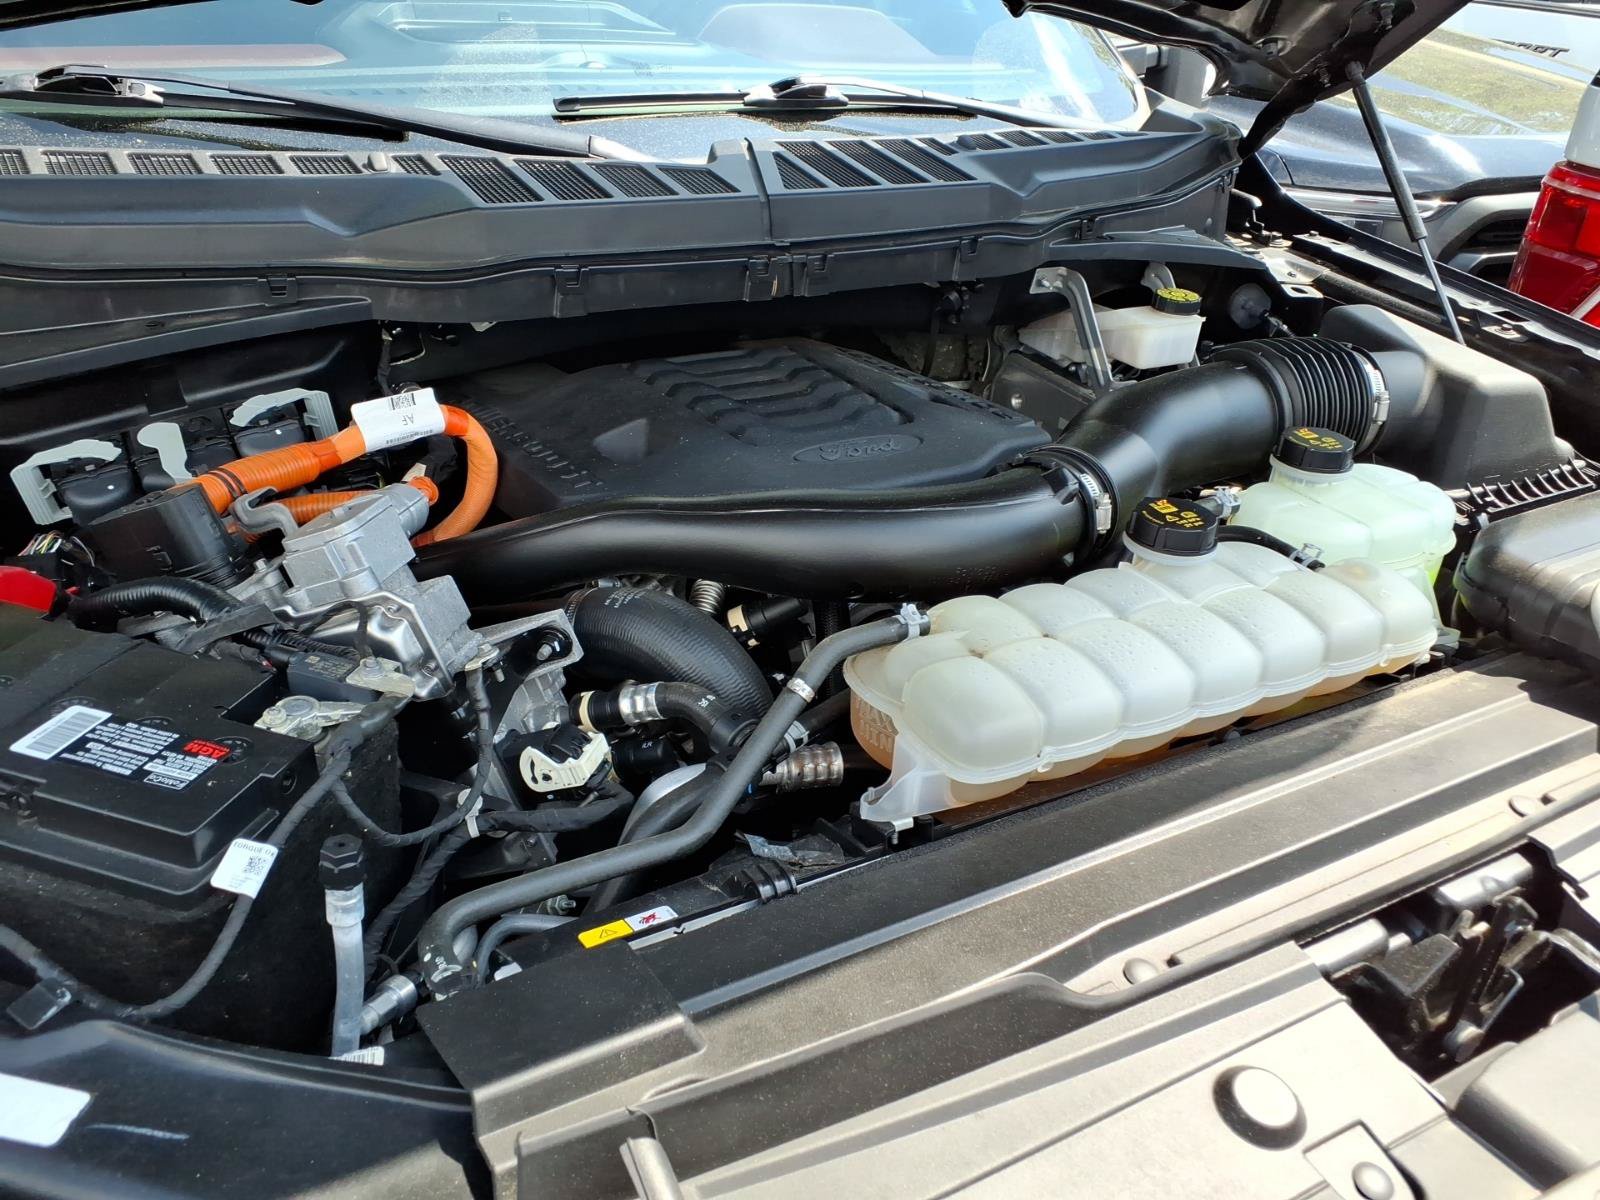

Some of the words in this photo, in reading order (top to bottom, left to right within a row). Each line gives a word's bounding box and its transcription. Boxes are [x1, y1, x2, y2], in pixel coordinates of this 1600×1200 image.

[818, 437, 903, 461] Ford
[183, 743, 228, 759] AGM
[148, 772, 185, 789] FoMoCo
